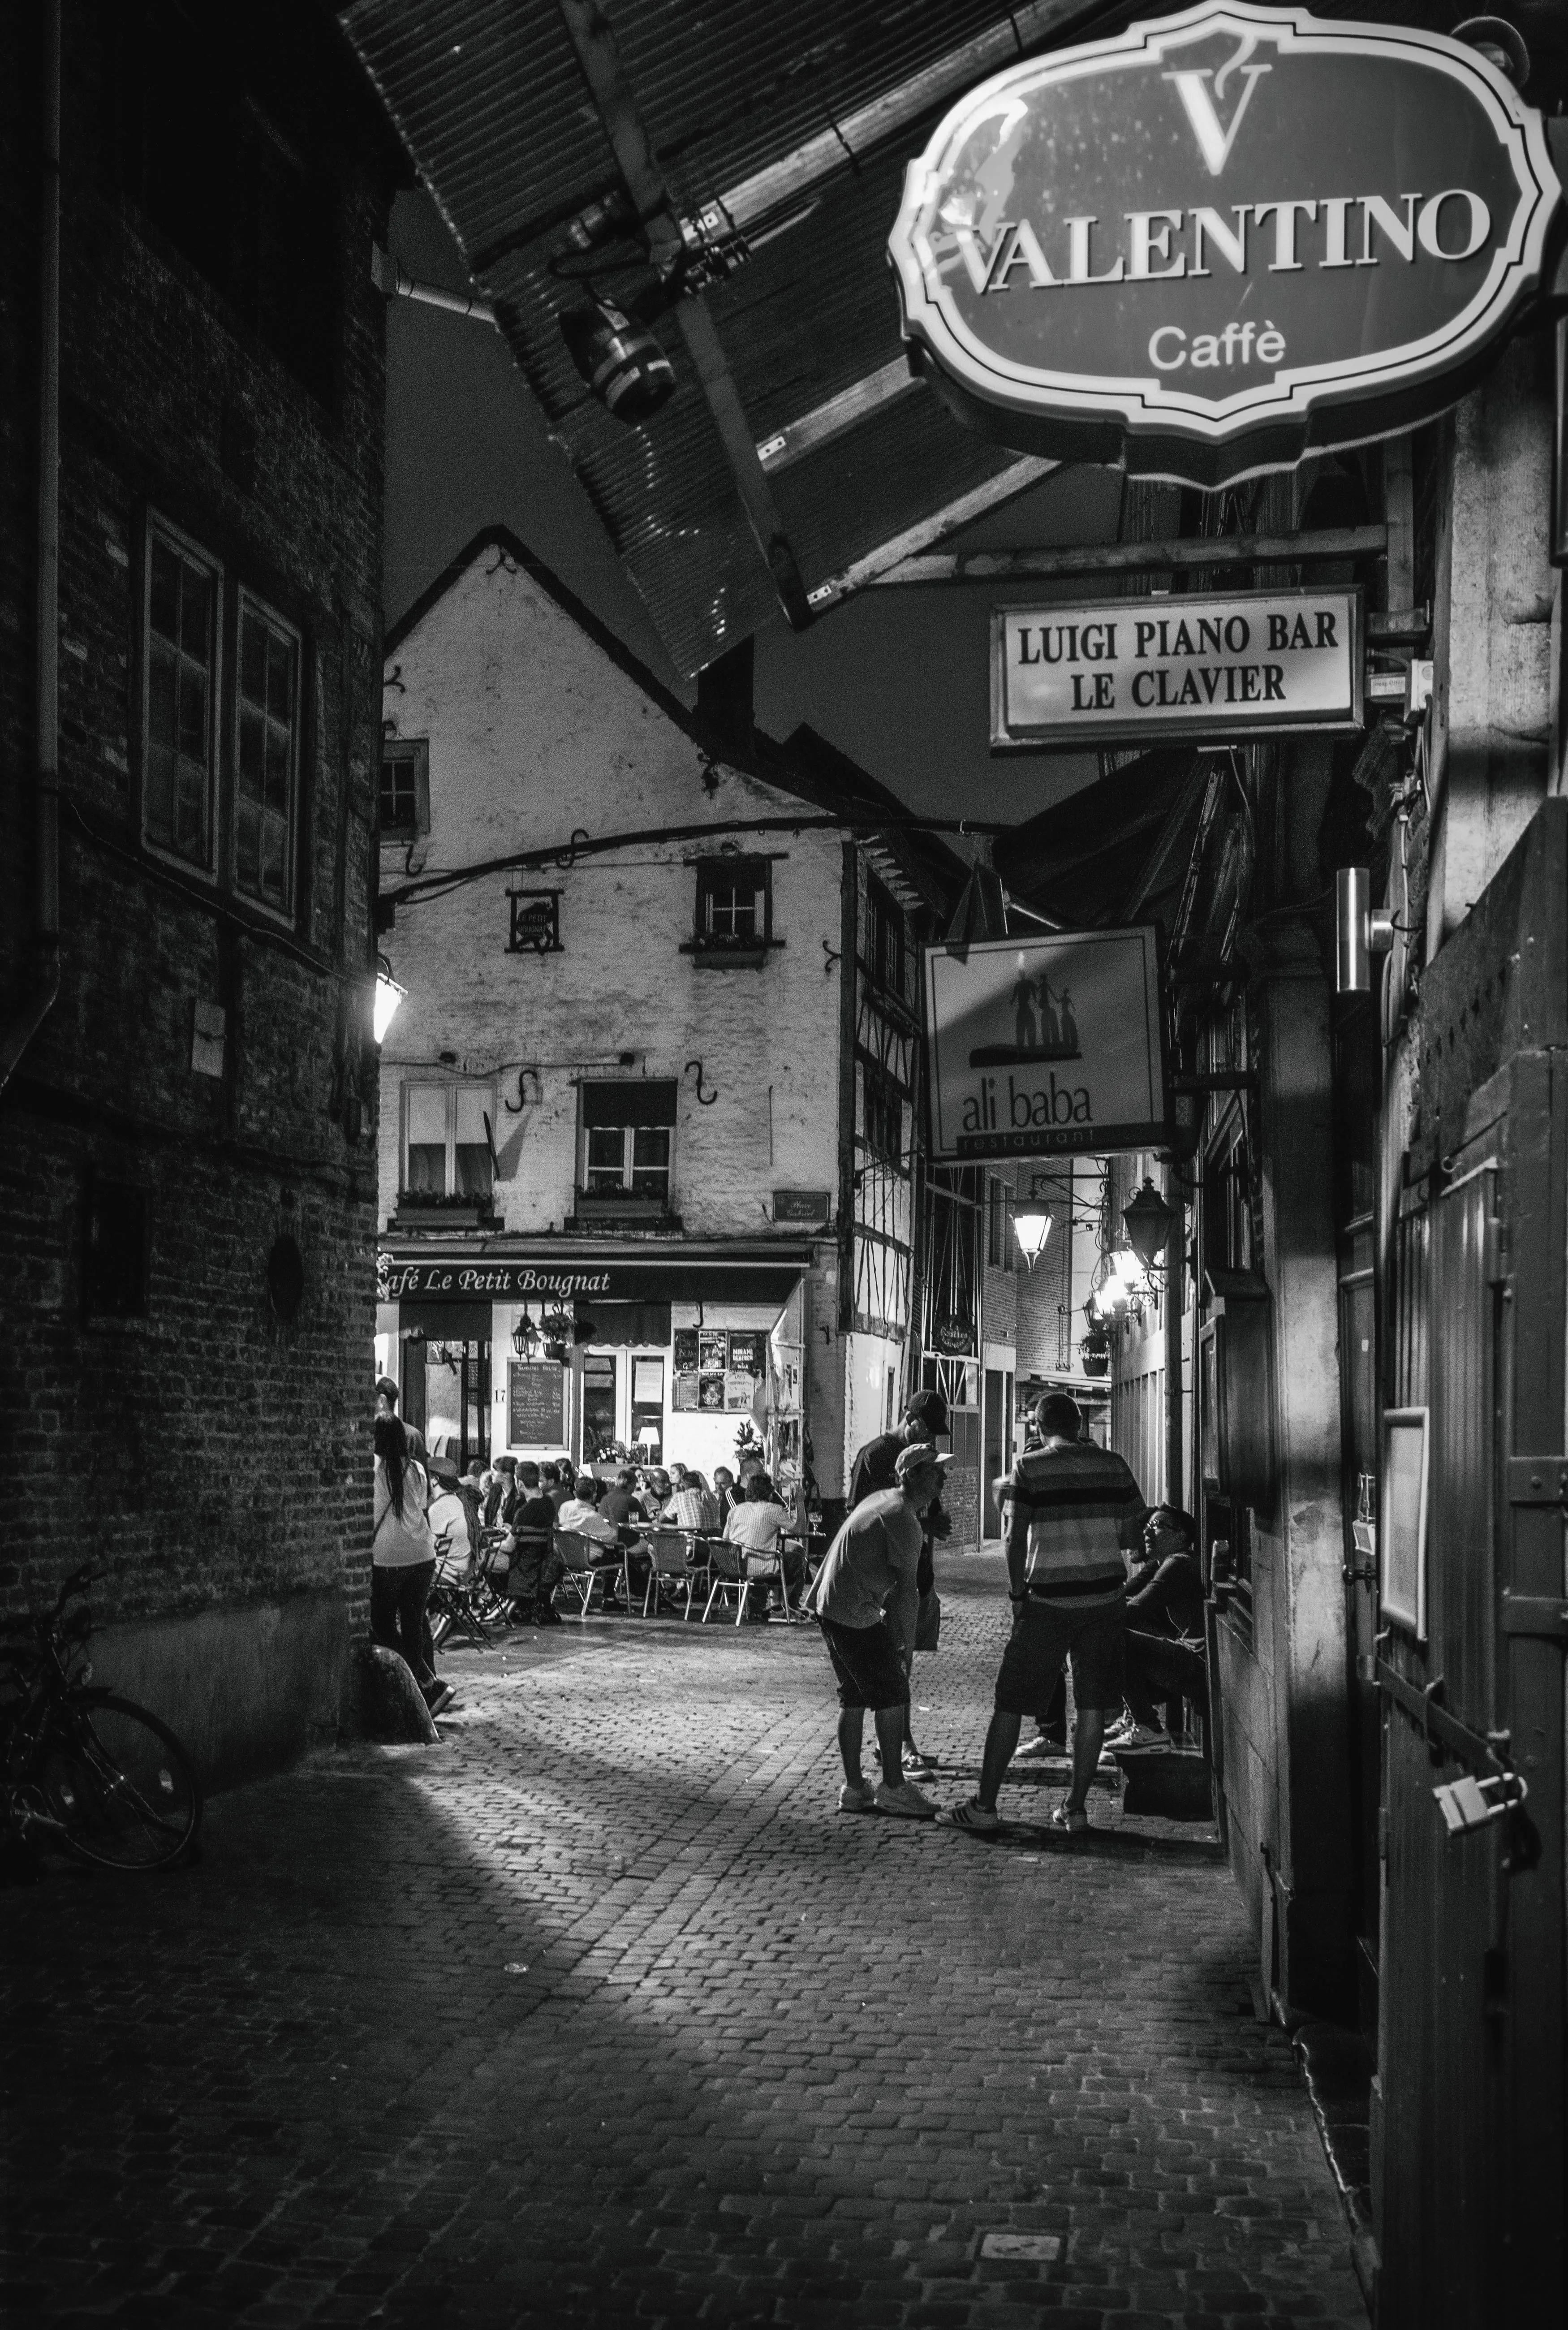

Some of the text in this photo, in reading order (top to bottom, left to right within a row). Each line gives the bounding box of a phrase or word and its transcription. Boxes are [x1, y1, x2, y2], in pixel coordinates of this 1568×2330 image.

[1162, 63, 1272, 176] V
[952, 189, 1491, 294] VALENTINO
[1148, 319, 1287, 371] Caffè
[1018, 611, 1339, 664] LUIGI PIANO BAR
[1070, 664, 1286, 711] LE CLAVIER
[963, 1071, 1093, 1132] ali baba
[964, 1128, 1094, 1151] restaurant
[386, 1266, 610, 1298] afé Le Petit Bougnat
[495, 1389, 506, 1402] 17
